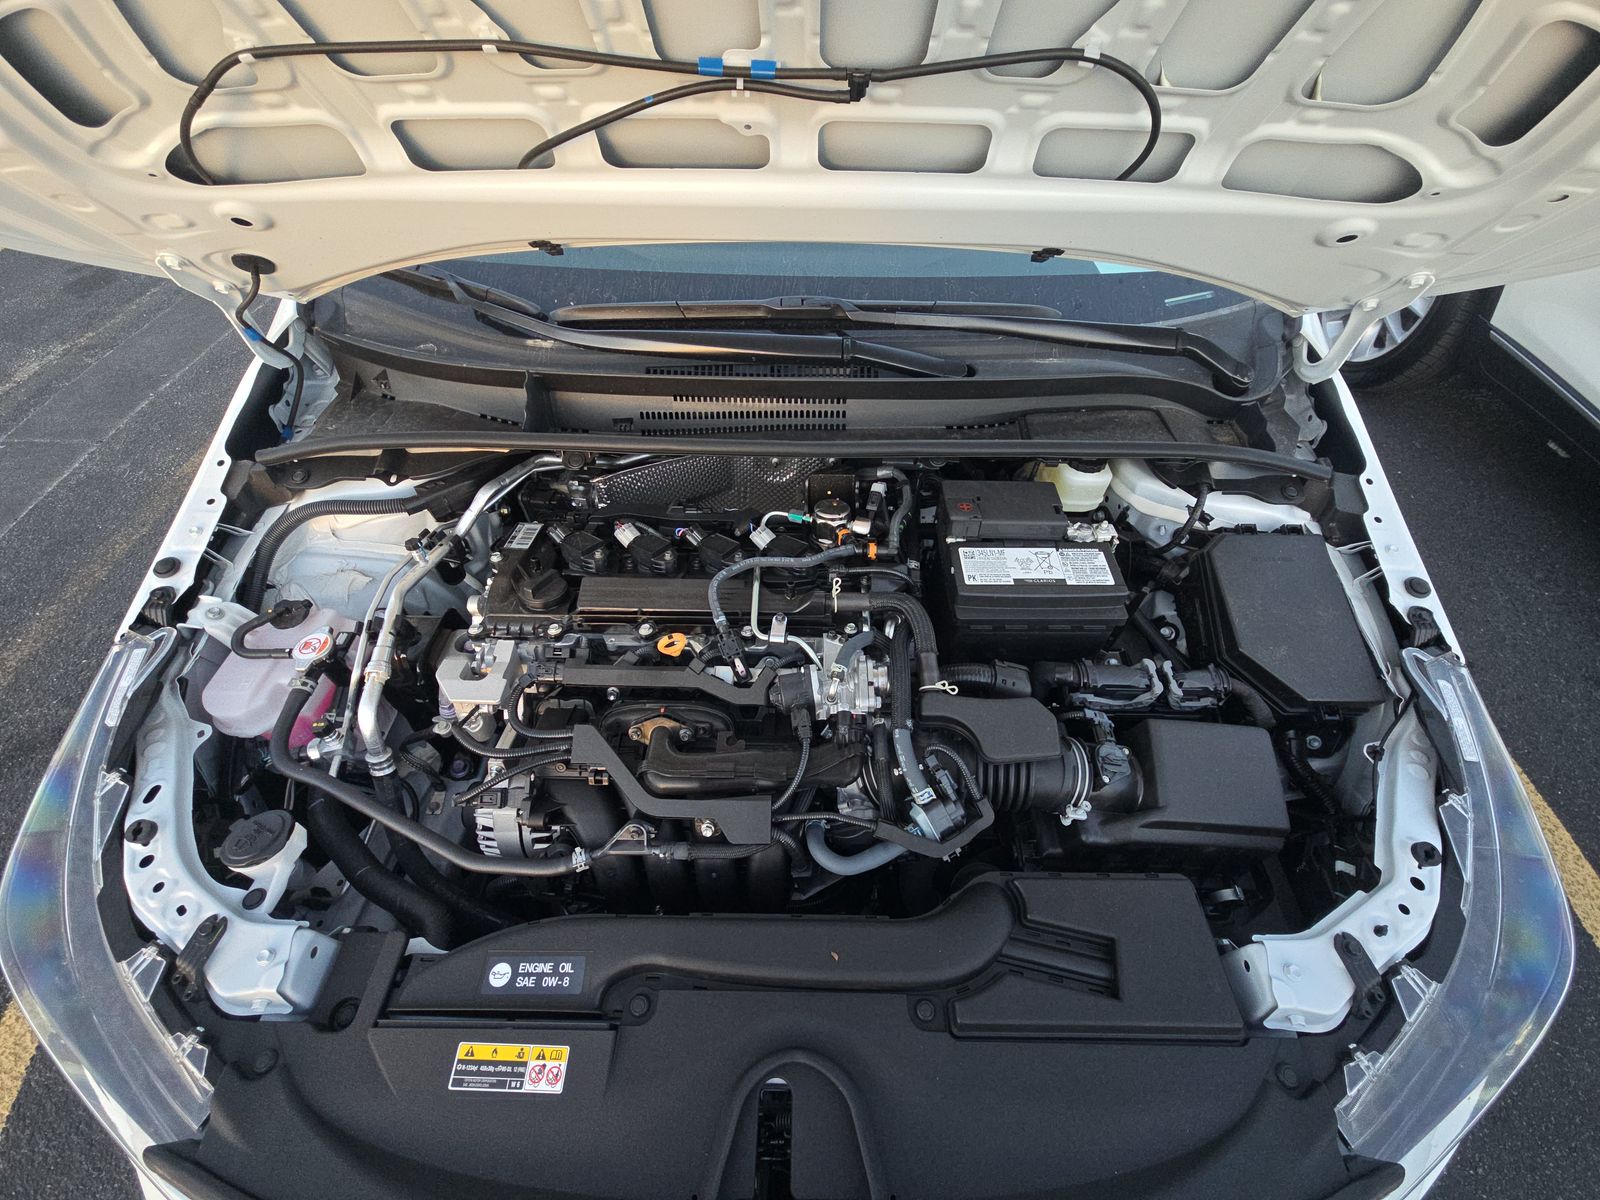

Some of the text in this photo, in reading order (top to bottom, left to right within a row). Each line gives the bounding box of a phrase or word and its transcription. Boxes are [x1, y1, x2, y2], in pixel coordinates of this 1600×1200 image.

[518, 962, 574, 973] ENGINE OIL
[515, 976, 570, 987] SAE 0W-8
